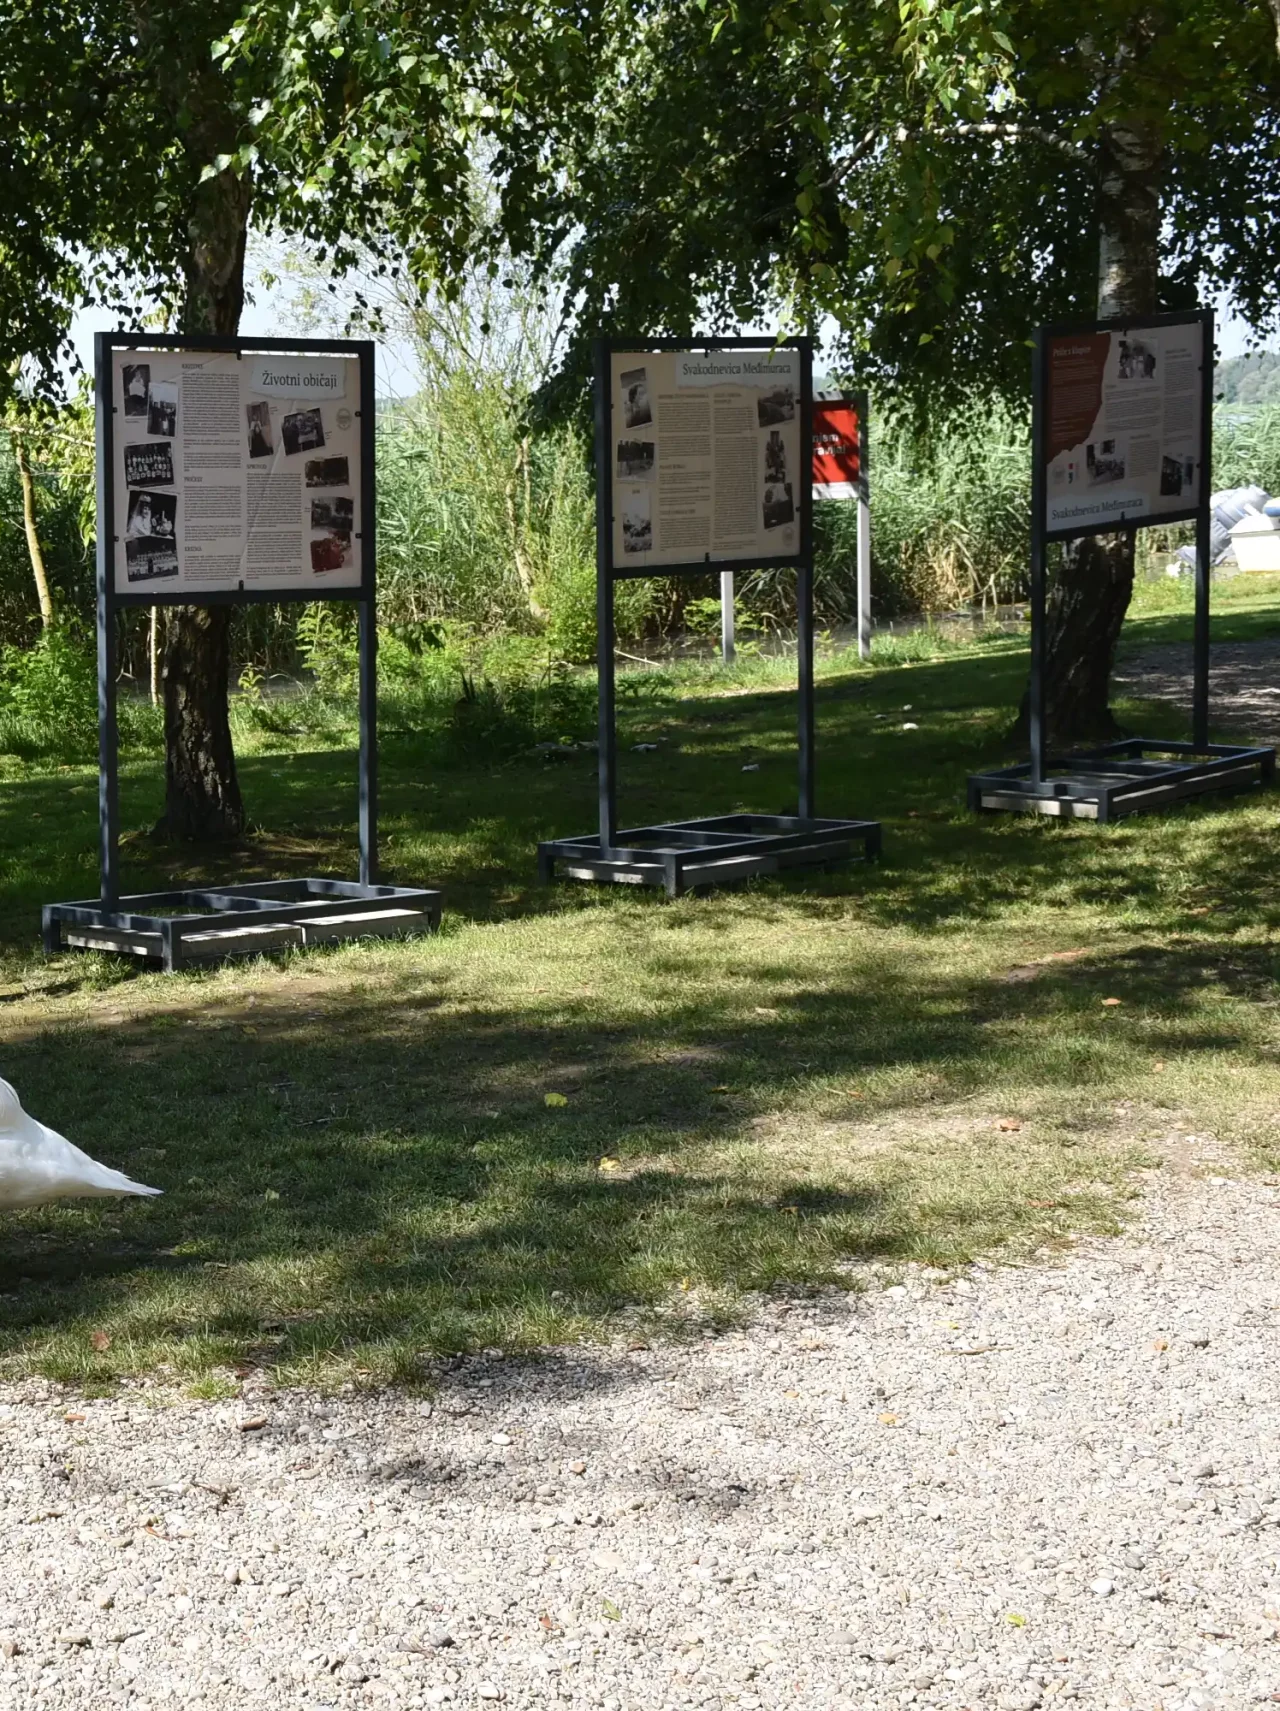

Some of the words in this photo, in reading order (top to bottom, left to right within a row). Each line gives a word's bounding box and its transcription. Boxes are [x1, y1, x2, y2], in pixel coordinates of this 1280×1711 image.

[682, 362, 741, 376] Svakodnevica
[262, 370, 301, 387] Životni
[303, 372, 338, 390] običaji
